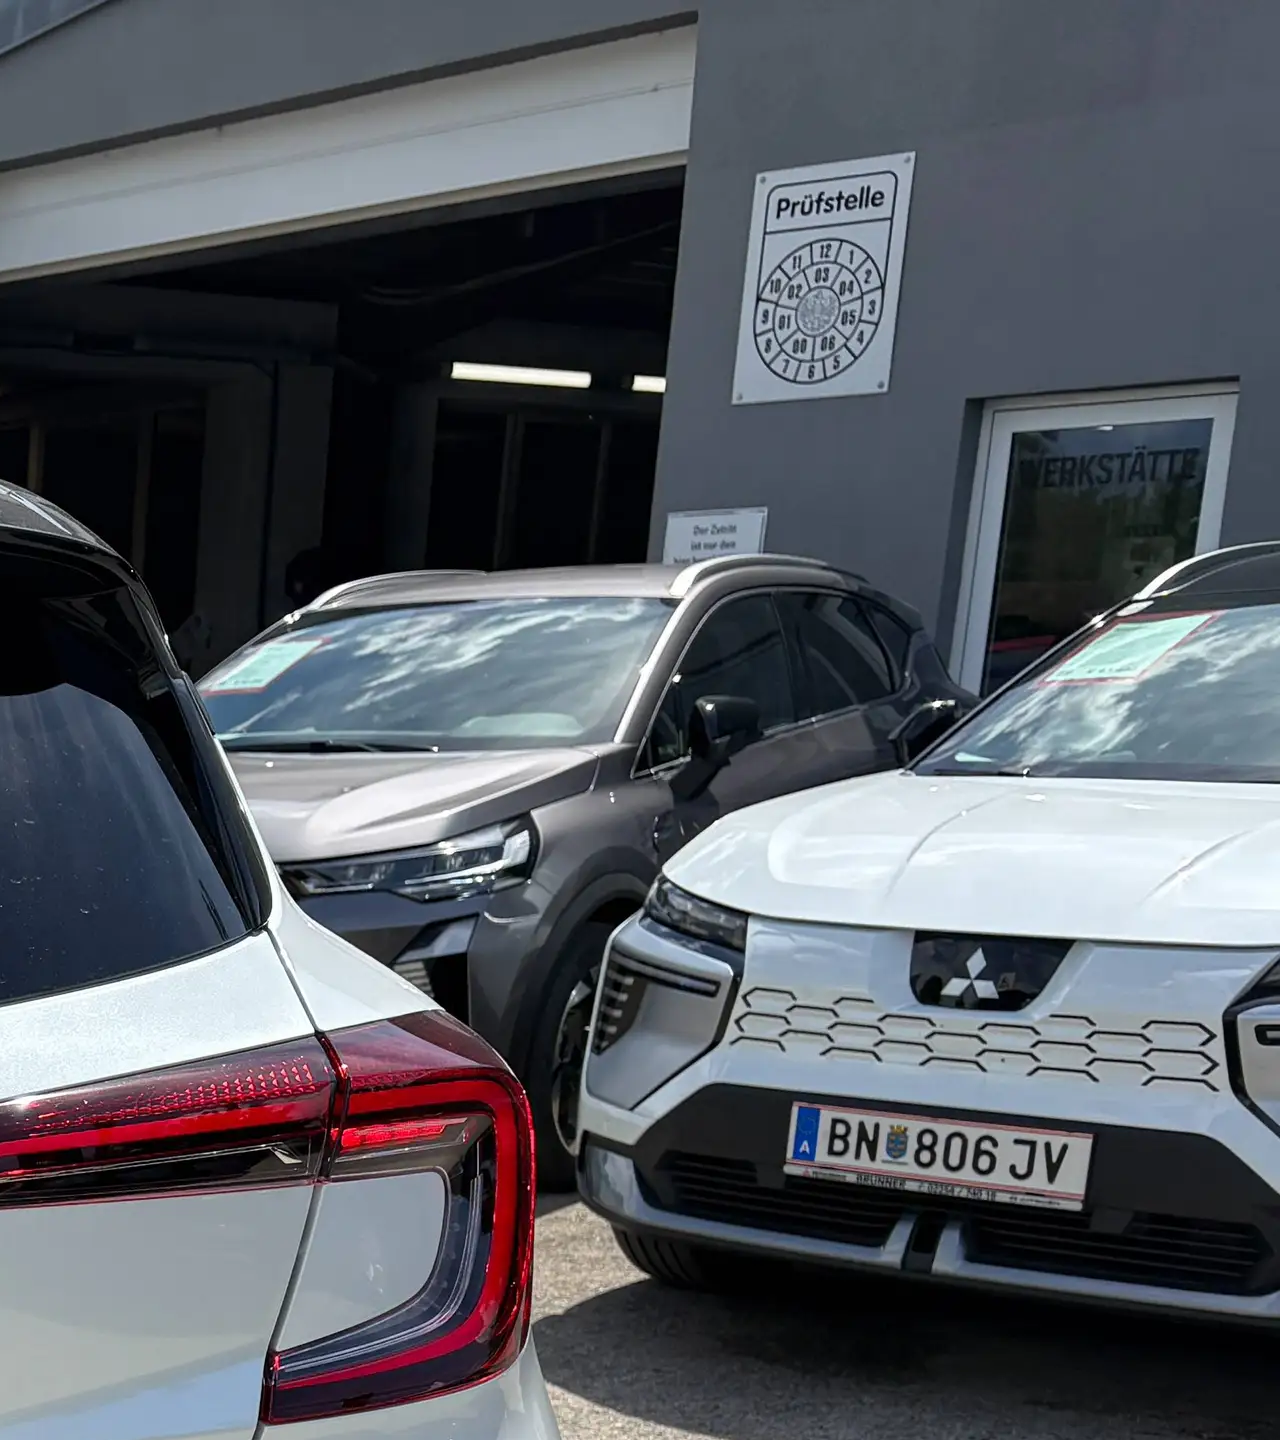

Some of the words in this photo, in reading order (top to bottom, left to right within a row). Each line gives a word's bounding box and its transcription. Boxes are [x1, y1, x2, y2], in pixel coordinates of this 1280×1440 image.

[776, 185, 885, 219] Prüfstelle
[820, 243, 832, 259] 12
[849, 249, 854, 265] 1
[793, 255, 802, 271] 11
[815, 267, 830, 283] 03
[864, 268, 873, 284] 2
[770, 278, 781, 294] 10
[787, 284, 802, 300] 02
[840, 280, 854, 296] 04
[868, 299, 876, 315] 3
[762, 309, 769, 324] 9
[778, 314, 791, 330] 01
[841, 309, 856, 326] 05
[765, 338, 772, 354] 8
[792, 338, 807, 354] 00
[857, 330, 864, 346] 4
[782, 359, 790, 374] 7
[833, 355, 841, 370] 5
[799, 1140, 810, 1155] A
[827, 1118, 880, 1162] BN
[914, 1128, 999, 1176] 806
[1008, 1138, 1069, 1185] JV
